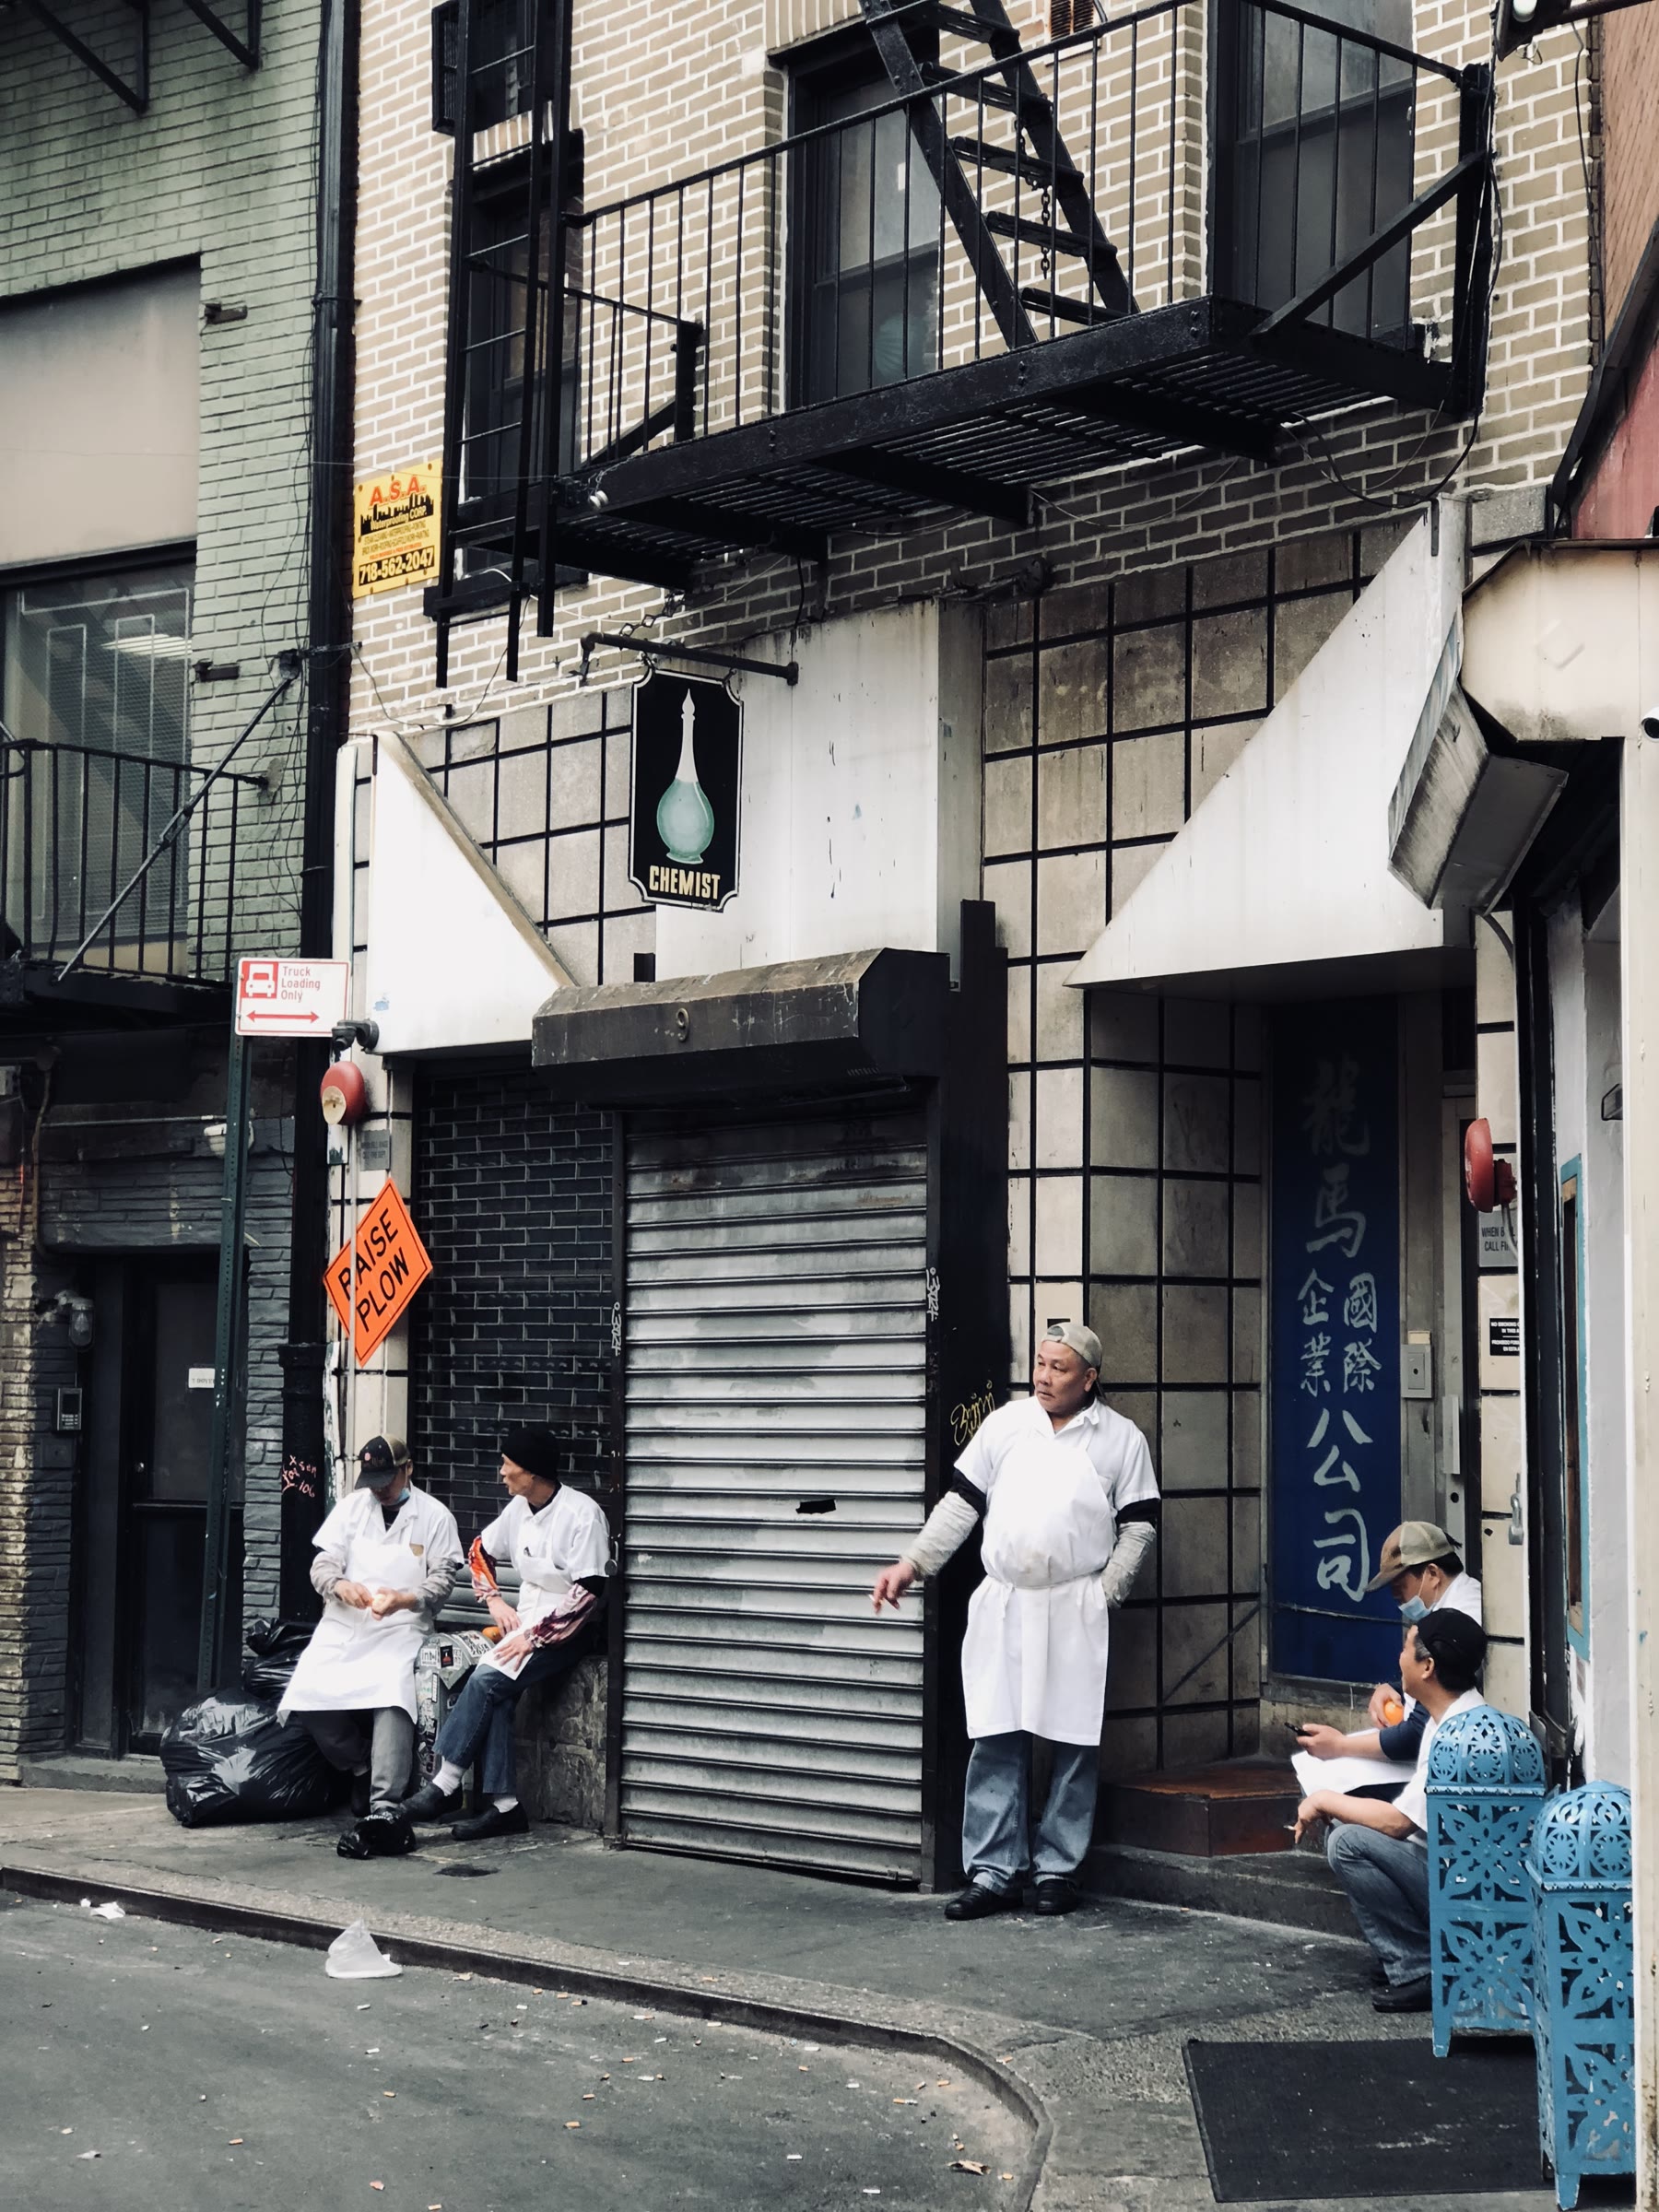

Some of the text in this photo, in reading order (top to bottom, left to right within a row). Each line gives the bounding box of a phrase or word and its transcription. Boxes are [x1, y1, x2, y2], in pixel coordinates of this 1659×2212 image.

[370, 475, 426, 507] A.S.A.
[359, 547, 433, 584] 718-562-2047
[649, 865, 721, 900] CHEMIST
[283, 966, 311, 977] Truck
[281, 978, 321, 991] Loading
[281, 990, 303, 1003] Only
[1481, 1226, 1500, 1237] WHEN
[337, 1207, 399, 1301] RAISE
[1485, 1241, 1499, 1252] CALL
[356, 1247, 410, 1333] PLOW
